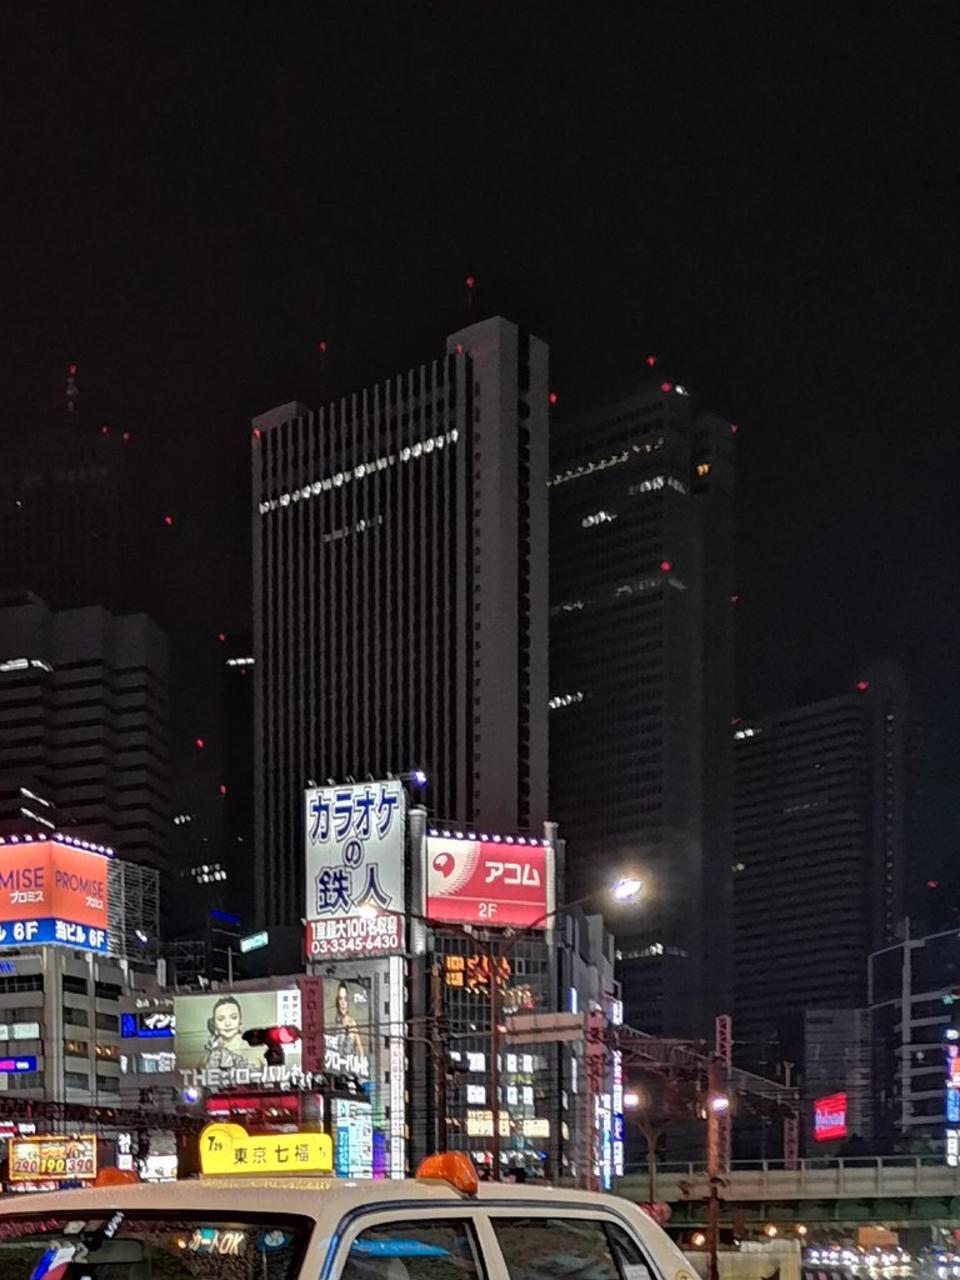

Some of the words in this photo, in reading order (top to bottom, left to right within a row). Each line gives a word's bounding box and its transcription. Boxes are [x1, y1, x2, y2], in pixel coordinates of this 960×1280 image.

[309, 785, 400, 844] カラオケ
[344, 838, 365, 868] の
[55, 870, 104, 898] PROMISE
[485, 861, 540, 886] アコム
[10, 891, 45, 904] プロミス
[317, 864, 393, 914] 鉄人
[478, 903, 497, 918] 2F
[13, 921, 39, 941] 6F
[55, 920, 86, 944] 当ビル
[90, 931, 105, 948] 6F
[311, 935, 398, 954] 03-3345-6430
[41, 1159, 65, 1173] 190
[68, 1159, 92, 1172] 390
[234, 1144, 309, 1165] 東京七福
